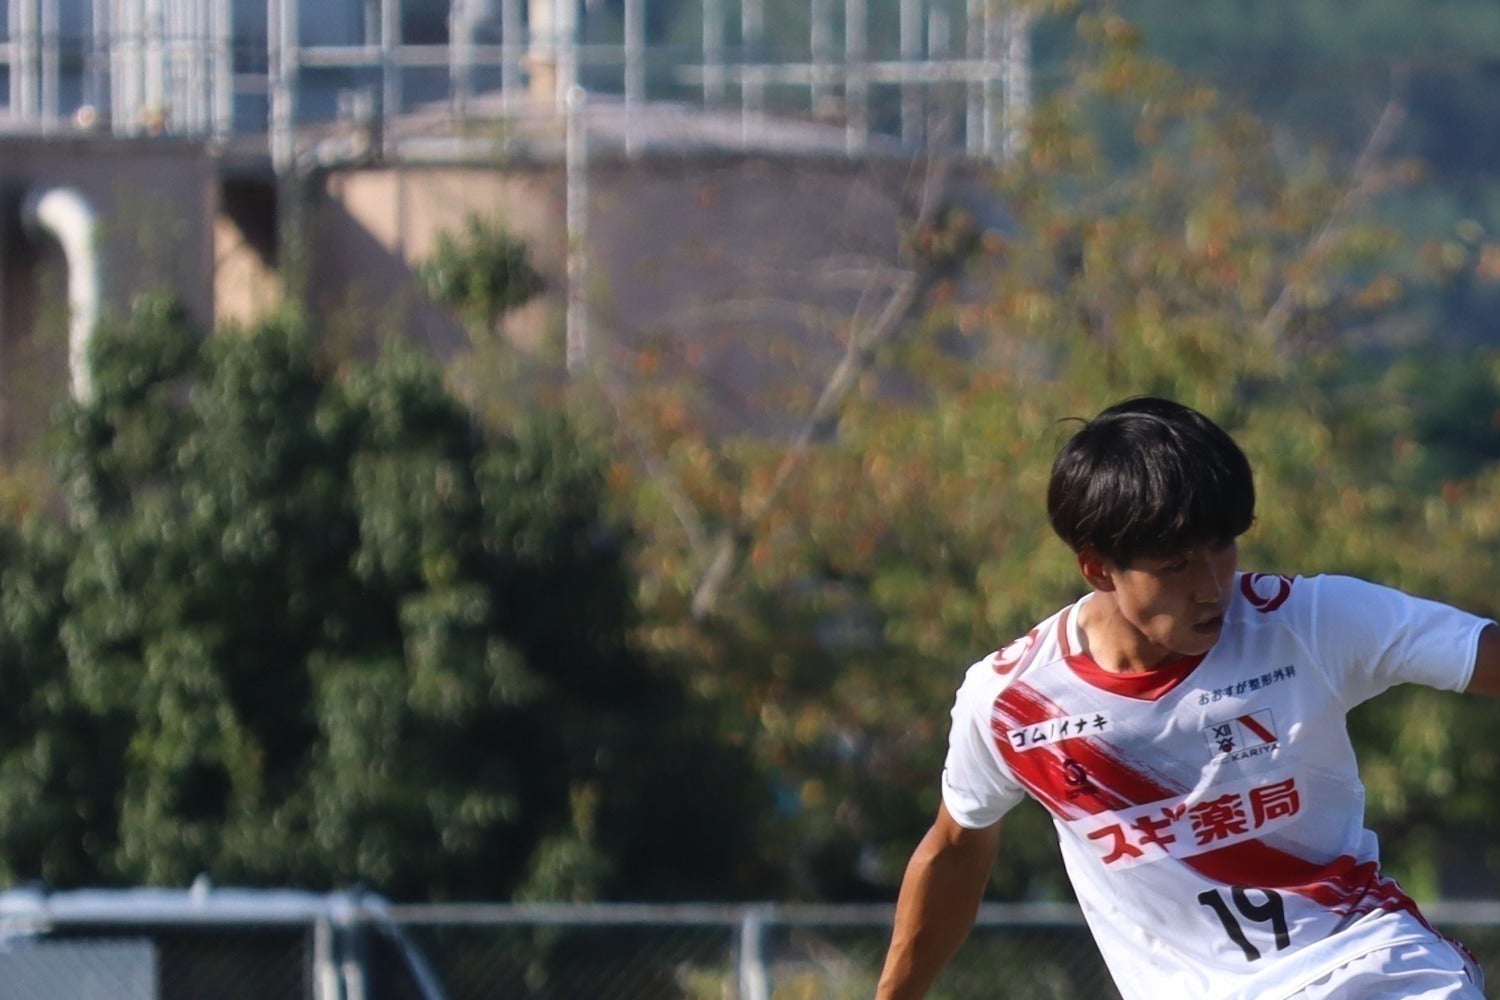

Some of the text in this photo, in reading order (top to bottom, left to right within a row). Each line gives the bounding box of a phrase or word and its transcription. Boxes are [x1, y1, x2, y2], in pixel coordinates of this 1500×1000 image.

[1198, 665, 1296, 706] おおすが整形外科
[1011, 713, 1108, 748] ゴムノイナキ
[1231, 743, 1279, 761] KARIYA
[1087, 777, 1300, 864] スギ薬局
[1198, 886, 1291, 962] 19
